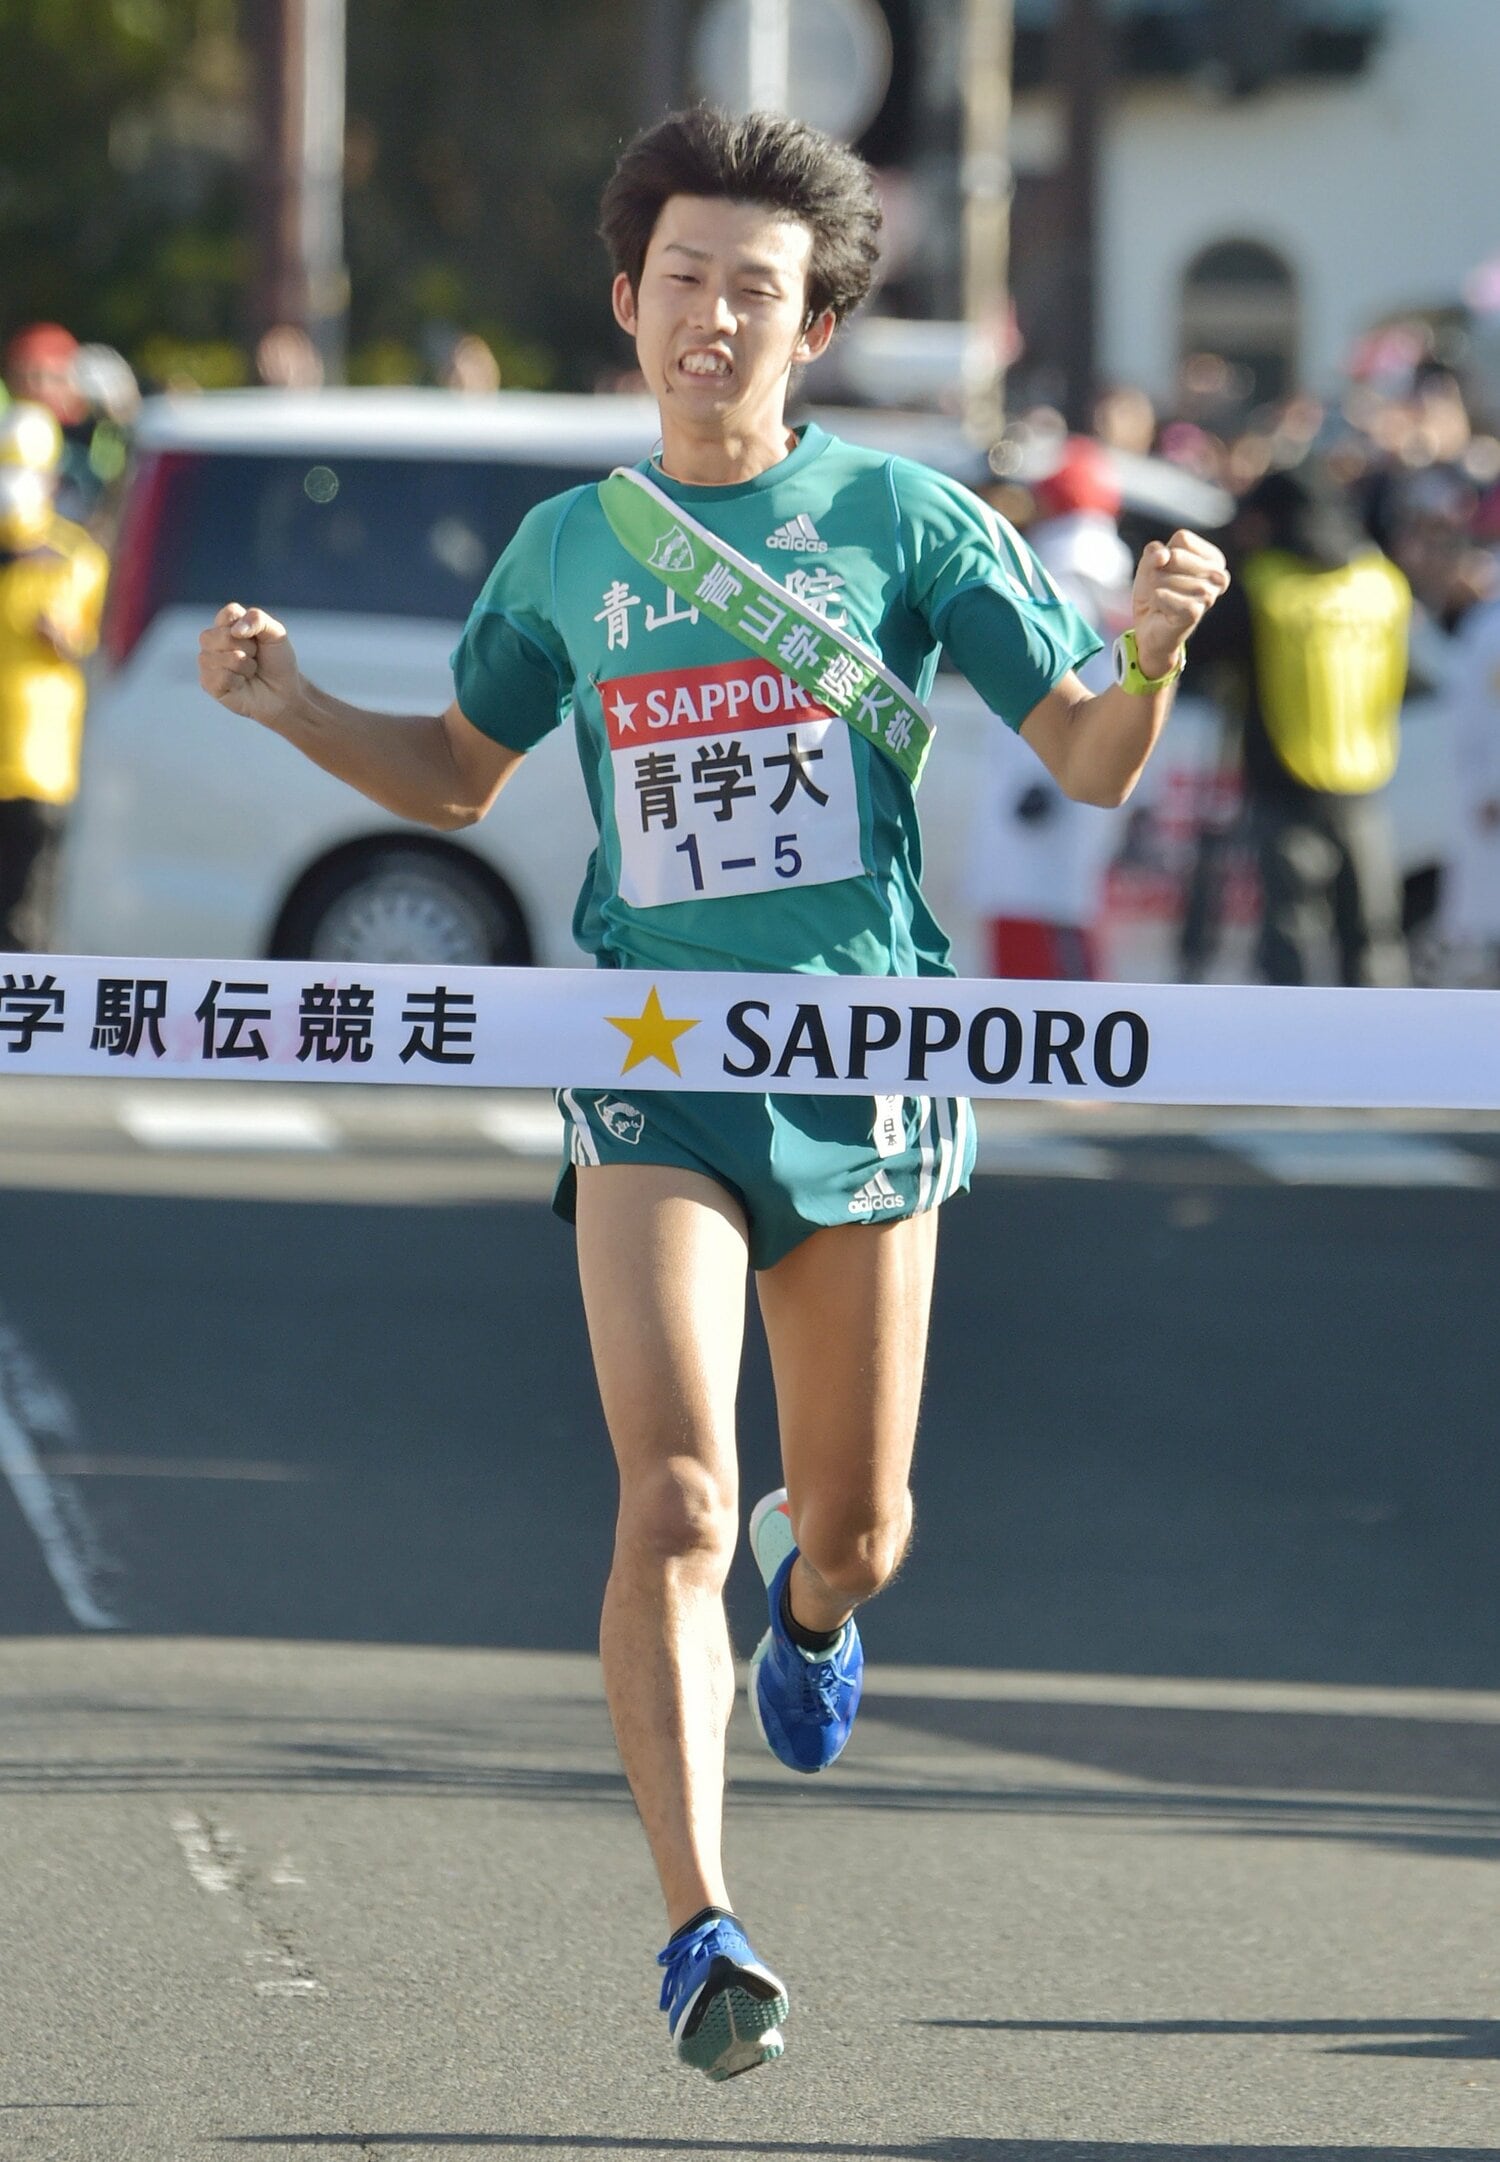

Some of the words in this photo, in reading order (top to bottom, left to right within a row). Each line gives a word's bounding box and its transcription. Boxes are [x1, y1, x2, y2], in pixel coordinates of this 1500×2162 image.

[765, 534, 829, 554] adidas
[594, 567, 848, 651] 青山院
[695, 560, 916, 754] 青山学院大学
[646, 672, 825, 729] SAPPOR
[634, 732, 830, 833] 青学大
[0, 974, 478, 1066] 学駅伝競走
[722, 1000, 1150, 1088] SAPPORO
[847, 1195, 905, 1214] adidas
